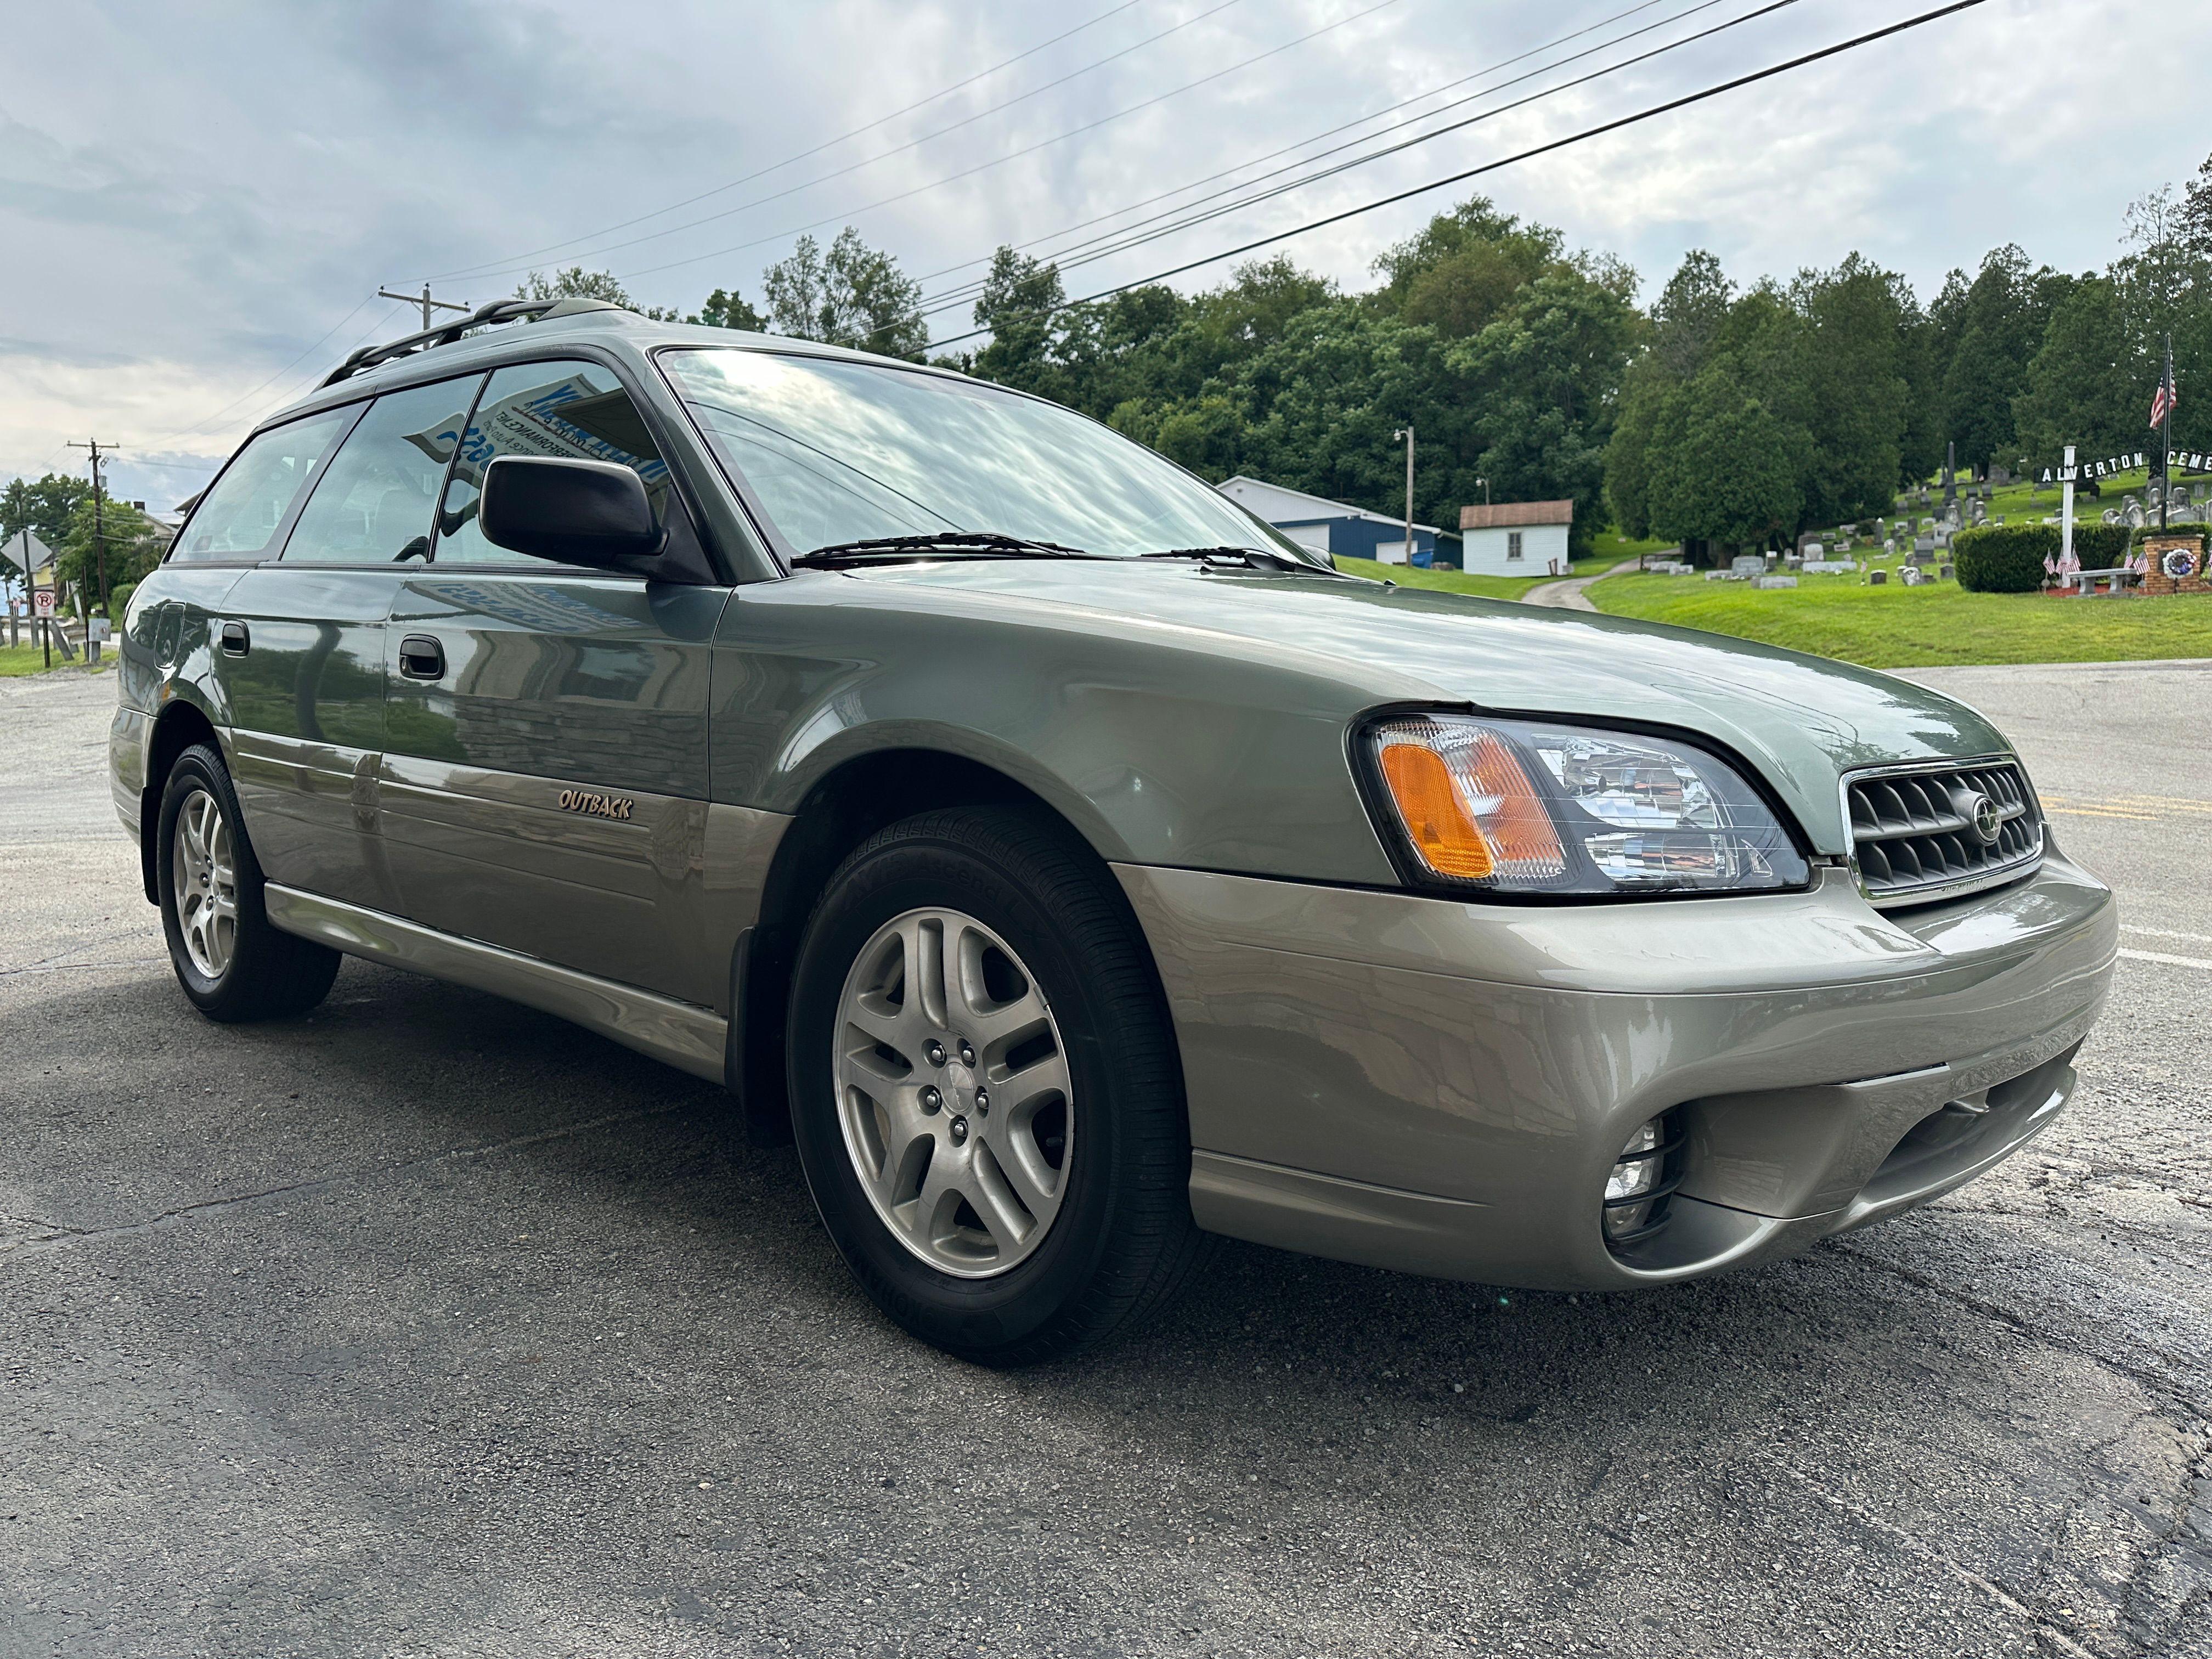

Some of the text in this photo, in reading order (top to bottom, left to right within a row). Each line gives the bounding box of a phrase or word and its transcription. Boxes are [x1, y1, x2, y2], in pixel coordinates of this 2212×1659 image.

[2042, 450, 2212, 482] ALVERTON CEME
[558, 790, 633, 820] OUTBACK
[838, 1232, 940, 1340] OKOHAMA
